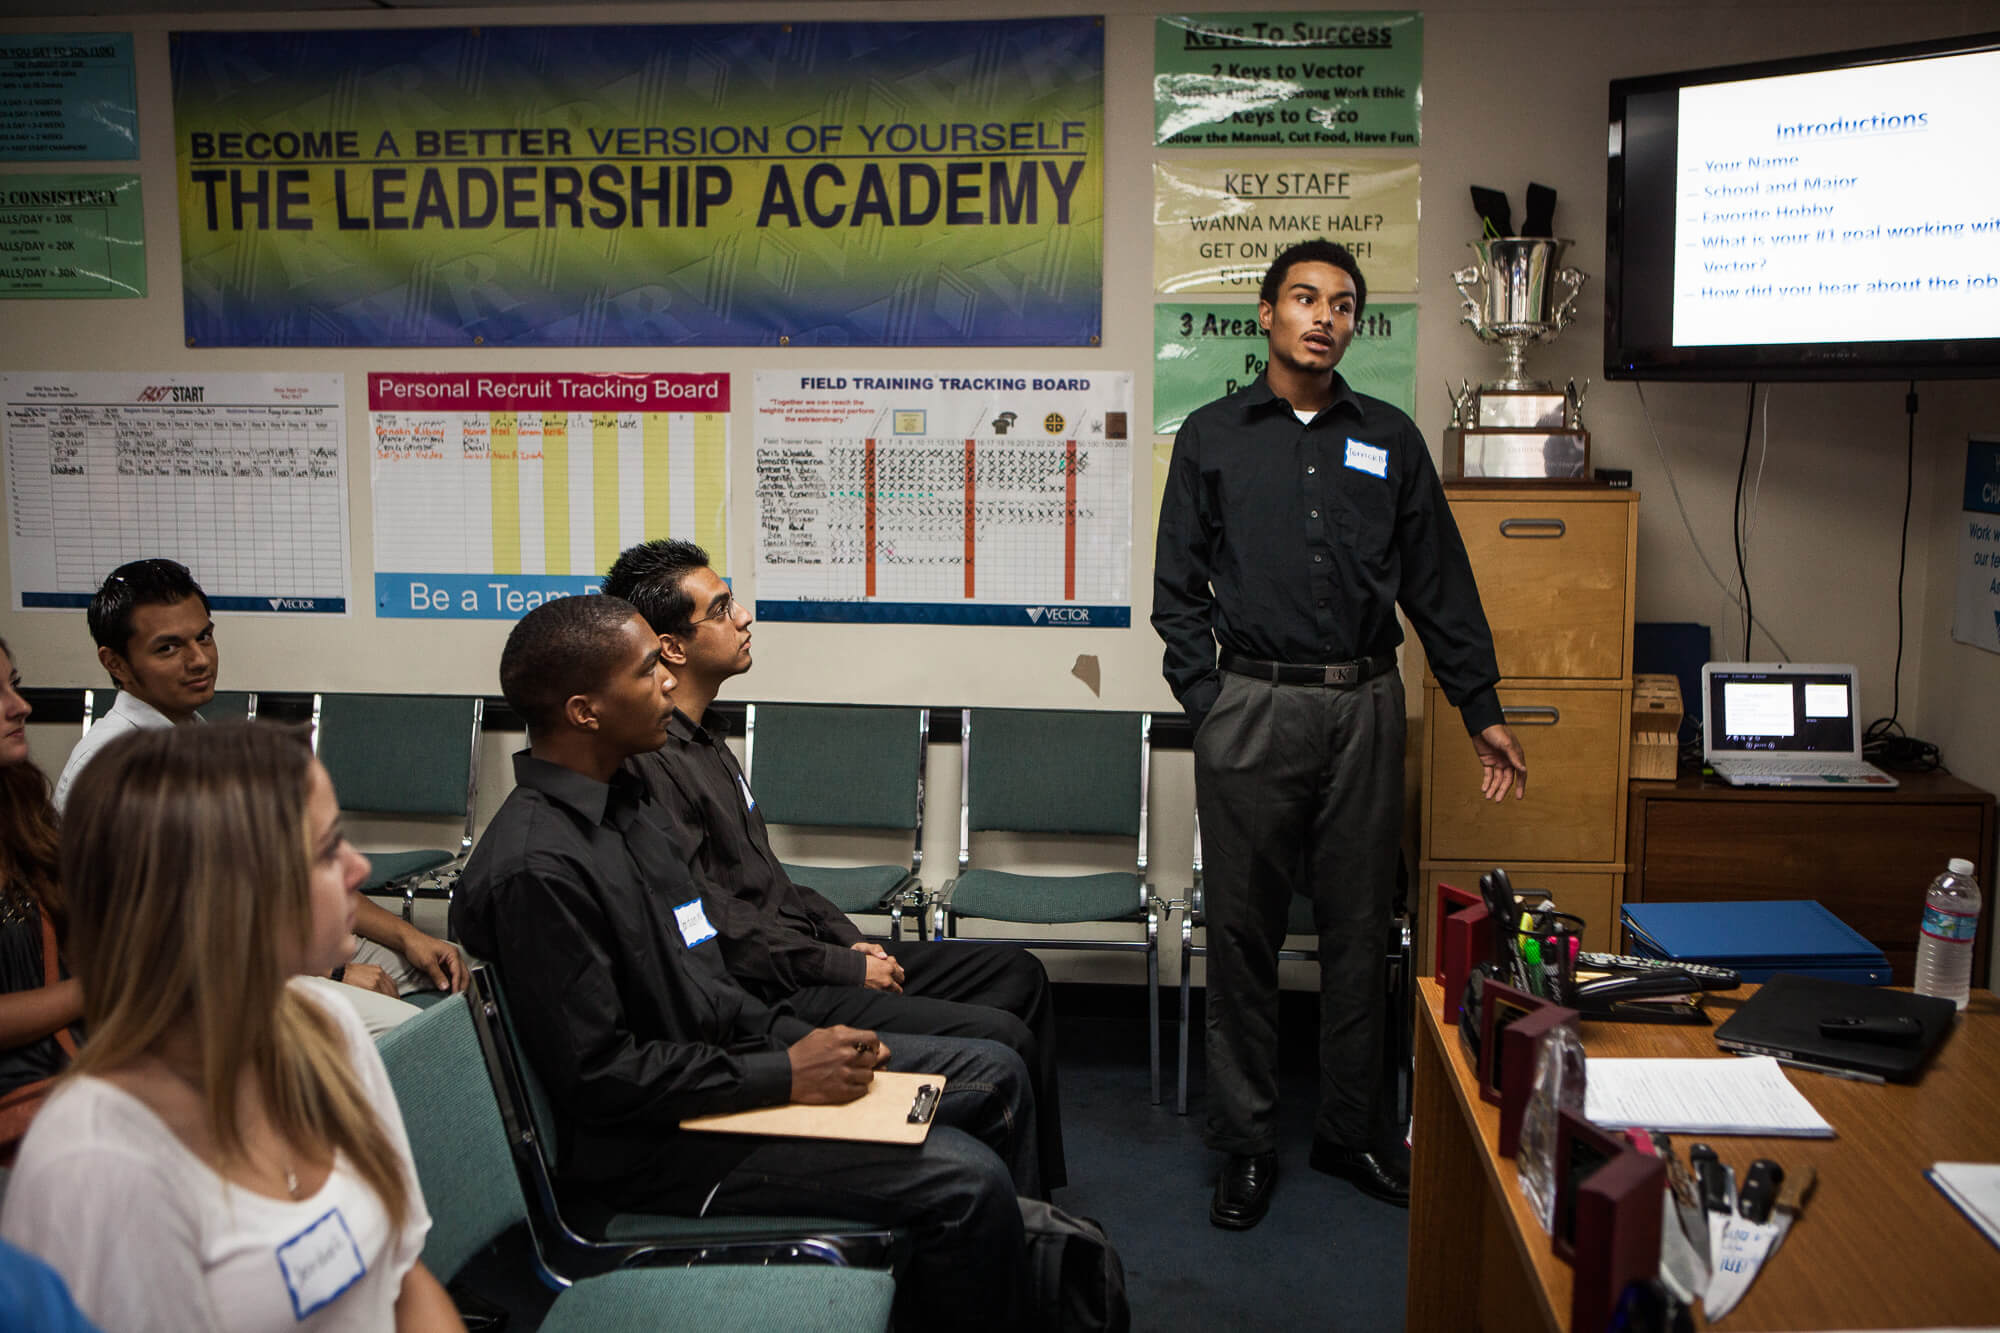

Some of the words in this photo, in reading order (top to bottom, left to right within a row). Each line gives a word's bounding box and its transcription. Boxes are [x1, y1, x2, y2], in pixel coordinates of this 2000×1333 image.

[1184, 23, 1245, 47] Keys
[1252, 23, 1284, 44] To
[1292, 23, 1393, 45] Success
[1229, 64, 1271, 80] Keys
[1277, 65, 1297, 79] to
[1302, 63, 1365, 79] Vector
[1334, 87, 1369, 99] Work
[1373, 86, 1405, 99] Ethic
[1232, 109, 1275, 127] Keys
[1280, 109, 1300, 124] to
[1306, 109, 1359, 124] Cco
[1776, 111, 1929, 141] Introductions
[191, 130, 360, 159] BECOME
[375, 130, 400, 158] A
[415, 128, 572, 157] BETTER
[588, 126, 769, 156] VERSION
[785, 124, 844, 153] OF
[858, 121, 1086, 152] YOURSELF
[1160, 132, 1202, 144] ollow
[1206, 131, 1227, 143] the
[1231, 131, 1284, 145] Manual,
[1288, 131, 1311, 143] Cut
[1314, 131, 1350, 145] Food,
[1354, 131, 1386, 143] Have
[1390, 131, 1414, 143] Fun
[1704, 159, 1743, 174] Your
[1748, 154, 1800, 170] Name
[1225, 173, 1270, 195] KEY
[1276, 172, 1350, 195] STAFF
[1703, 181, 1760, 200] School
[1765, 178, 1798, 194] and
[1803, 175, 1859, 193] Major
[191, 168, 314, 231] THE
[334, 164, 733, 231] LEADERSHIP
[756, 160, 1086, 228] ACADEMY
[55, 214, 73, 224] 10K
[1190, 215, 1263, 232] WANNA
[1269, 215, 1321, 232] MAKE
[1327, 214, 1384, 232] HALF?
[1702, 207, 1771, 225] Favorite
[1776, 203, 1835, 222] Hobby
[1702, 234, 1747, 249] What
[1752, 233, 1766, 247] is
[1770, 233, 1809, 248] your
[1815, 228, 1836, 243] #1
[1842, 225, 1881, 244] goal
[1886, 221, 1965, 238] working
[1971, 216, 2000, 233] wit
[0, 241, 46, 252] ALLS/DAY
[56, 241, 76, 251] 20K
[1200, 242, 1235, 259] GET
[1240, 242, 1268, 258] ON
[0, 268, 47, 280] ALLS/DAY
[1703, 257, 1768, 275] Vector?
[1701, 286, 1740, 300] How
[1744, 284, 1773, 298] did
[1778, 284, 1813, 300] you
[1818, 280, 1861, 296] hear
[1866, 274, 1921, 292] about
[1927, 274, 1960, 290] the
[1180, 313, 1194, 336] 3
[1201, 313, 1270, 337] Areas
[172, 386, 205, 402] START
[378, 380, 470, 398] Personal
[477, 380, 552, 399] Recruit
[557, 380, 648, 403] Tracking
[654, 380, 719, 399] Board
[800, 377, 848, 391] FIELD
[852, 377, 934, 391] TRAINING
[939, 377, 1027, 391] TRACKING
[1032, 378, 1091, 392] BOARD
[1969, 521, 1991, 541] Work
[282, 599, 314, 609] VECTOR
[410, 582, 450, 611] Be
[460, 589, 479, 611] a
[1044, 608, 1089, 621] VECTOR
